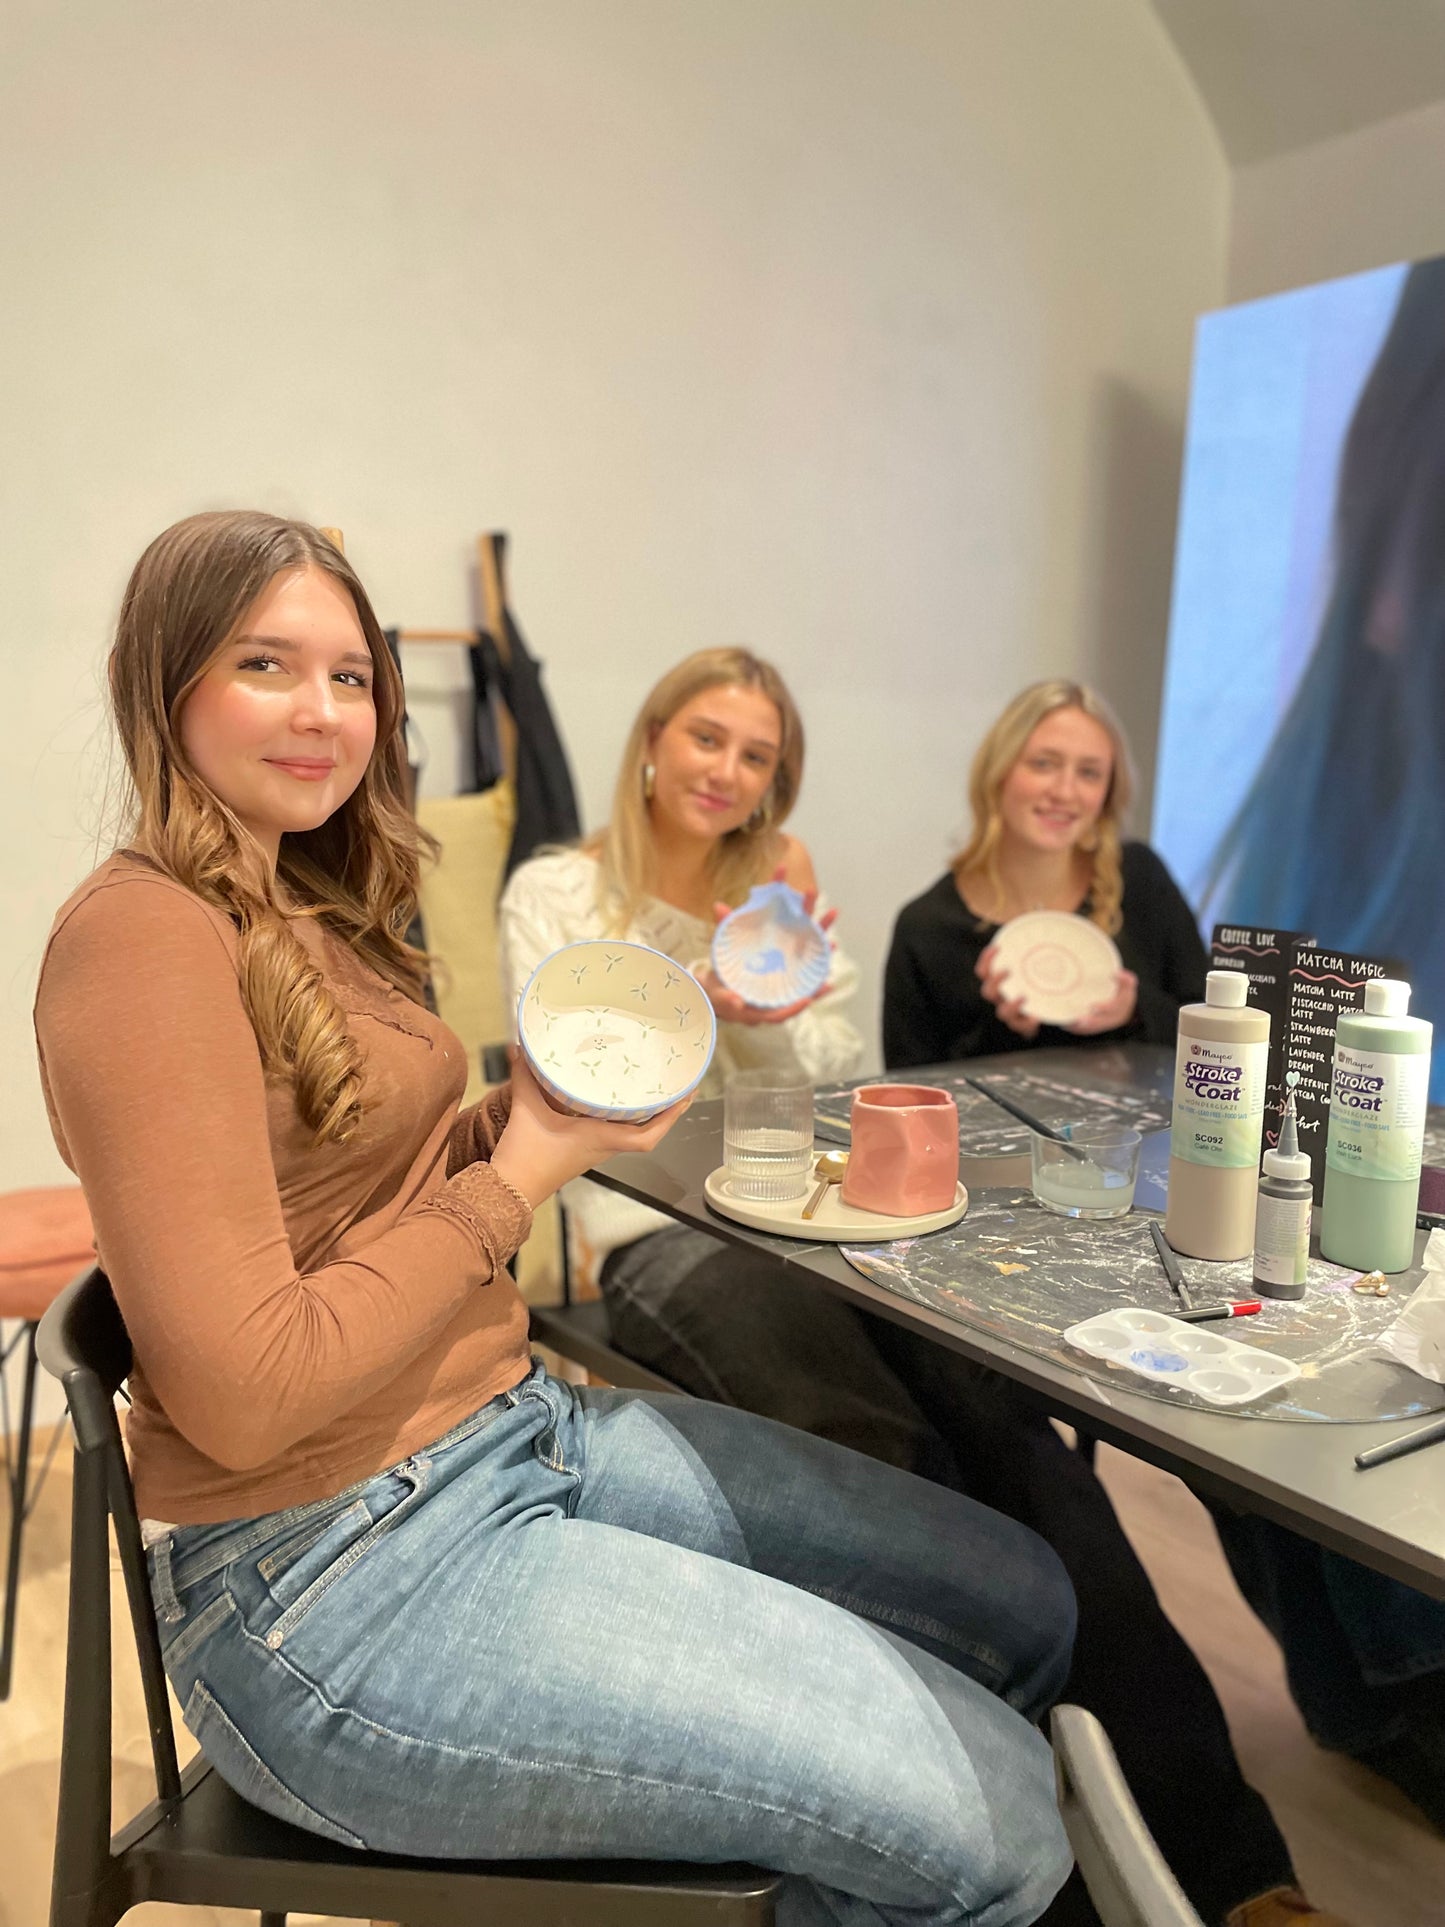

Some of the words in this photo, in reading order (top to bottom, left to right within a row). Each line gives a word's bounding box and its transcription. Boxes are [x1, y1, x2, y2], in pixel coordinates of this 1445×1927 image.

[1221, 928, 1251, 946] COFFEE
[1256, 933, 1276, 947] LOVE
[1296, 952, 1344, 973] MATCHA
[1350, 960, 1386, 979] MAGIC
[1293, 982, 1325, 997] MATCHA
[1330, 988, 1356, 1002] LATTE
[1291, 996, 1335, 1013] PISTACCHIO
[1290, 1007, 1314, 1020] LATTE
[1290, 1033, 1312, 1046] LATTE
[1201, 1047, 1233, 1064] Mayco
[1288, 1046, 1326, 1063] LAVENDER
[1188, 1063, 1239, 1082] Stroke
[1288, 1059, 1314, 1074] DREAM
[1345, 1056, 1375, 1072] Mayco
[1334, 1069, 1379, 1092] Stroke
[1194, 1082, 1242, 1102] Coat
[1339, 1089, 1383, 1112] Coat
[1194, 1133, 1224, 1145] SC092
[1337, 1140, 1362, 1153] SC036
